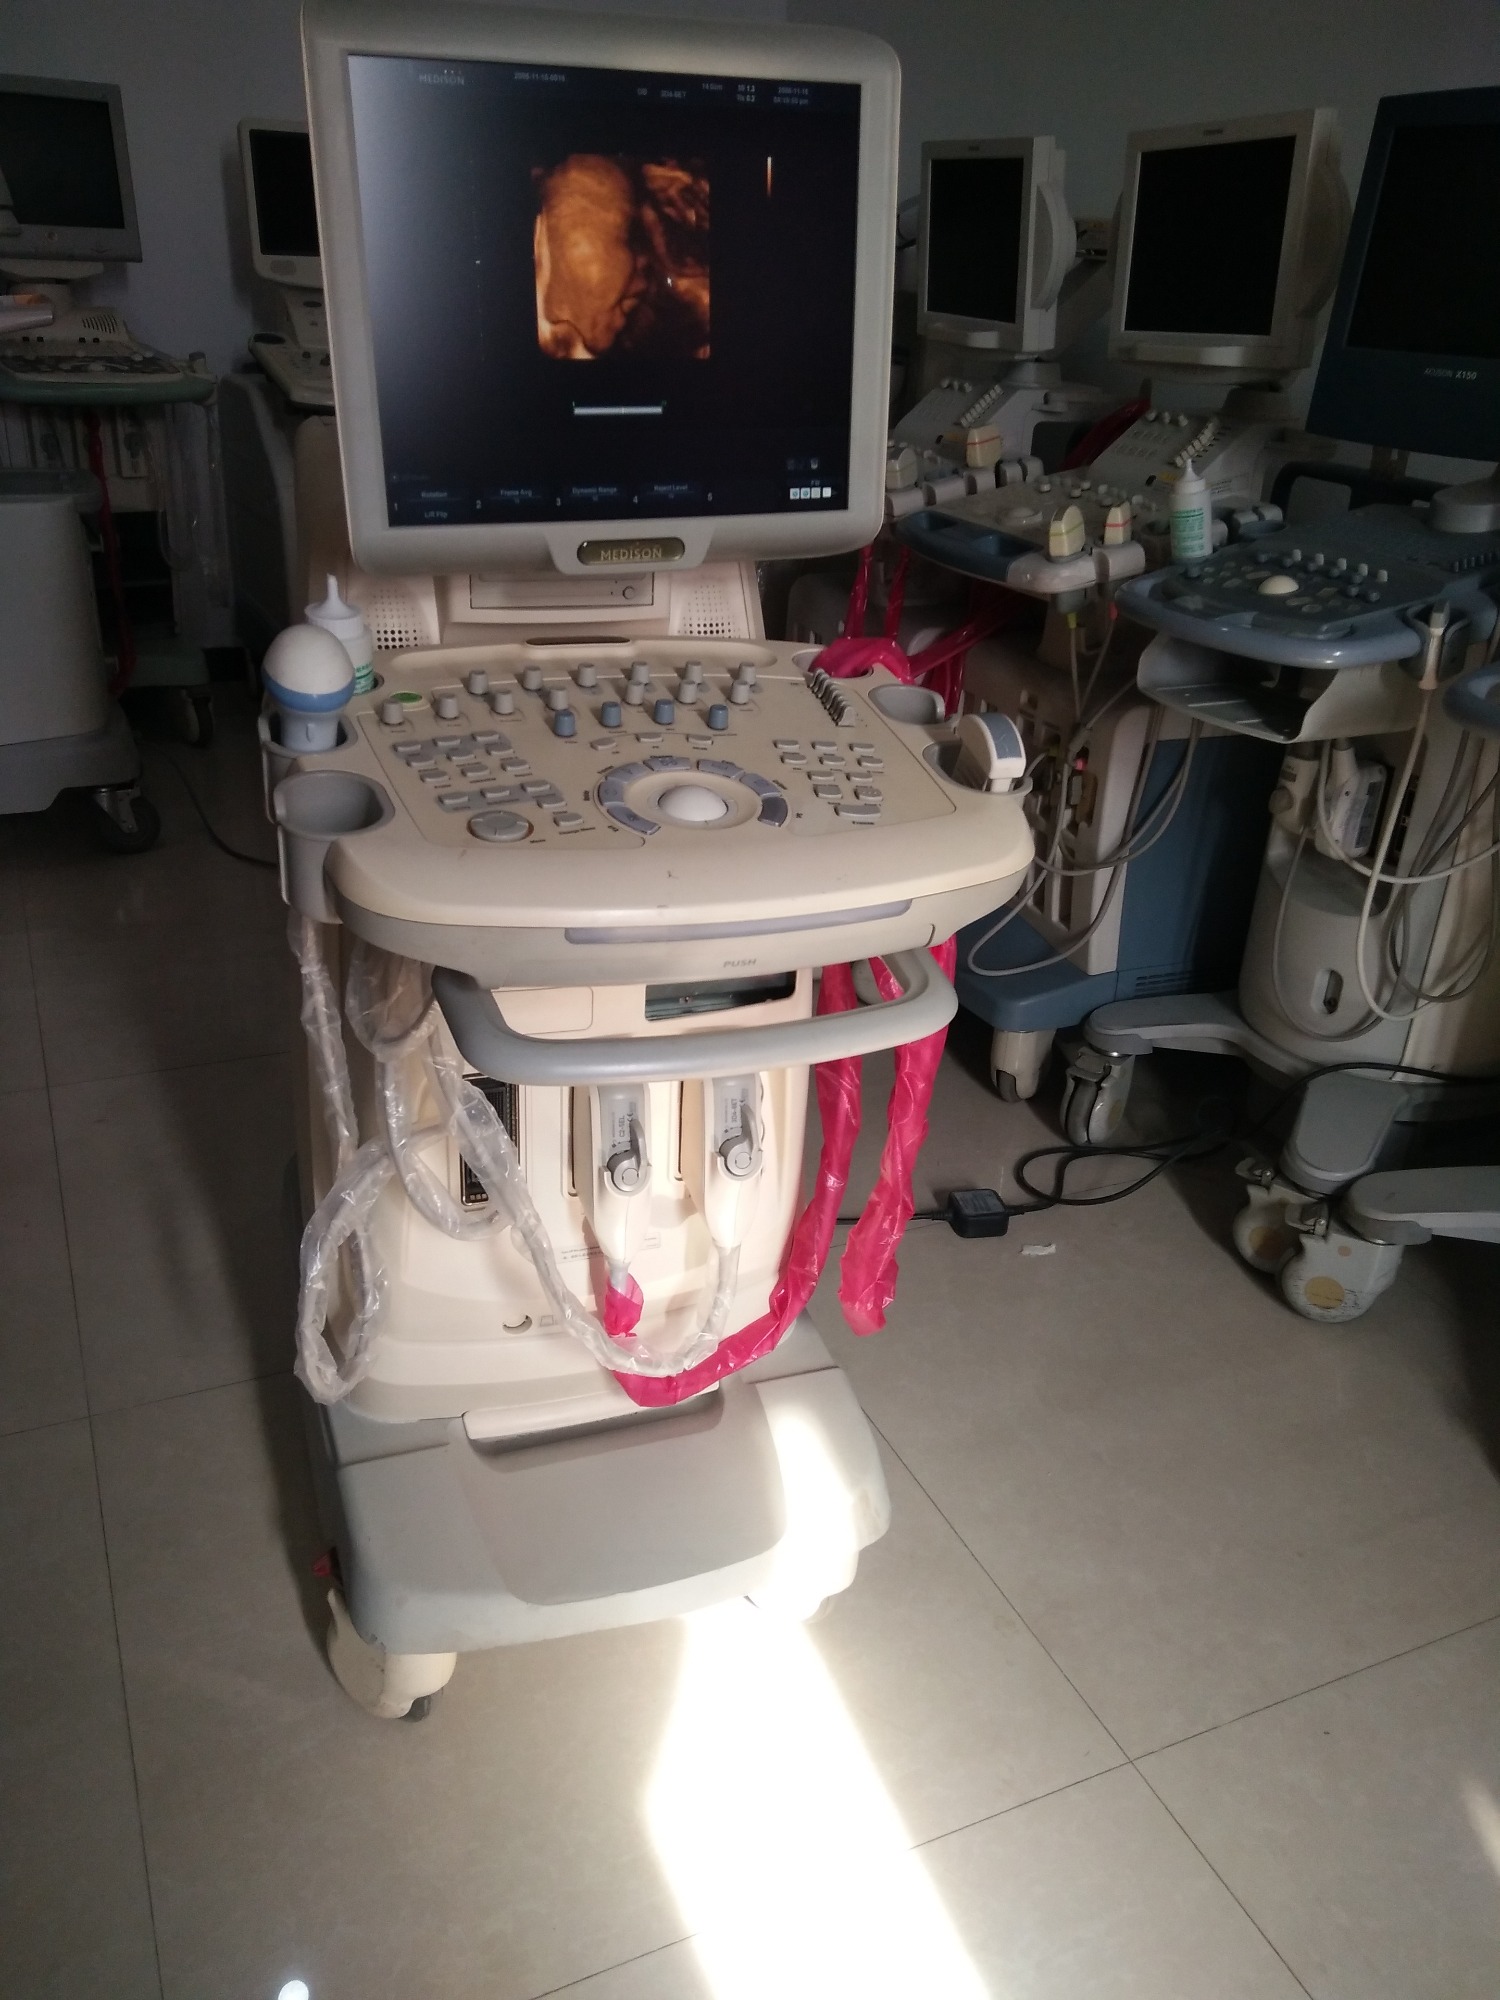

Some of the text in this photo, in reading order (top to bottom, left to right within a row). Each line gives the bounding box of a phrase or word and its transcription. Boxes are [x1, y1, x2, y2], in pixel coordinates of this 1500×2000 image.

[418, 73, 465, 86] MEDISON
[1455, 369, 1478, 381] X150
[475, 499, 482, 510] 2
[600, 547, 663, 561] MEDISON
[722, 958, 758, 968] PUSH
